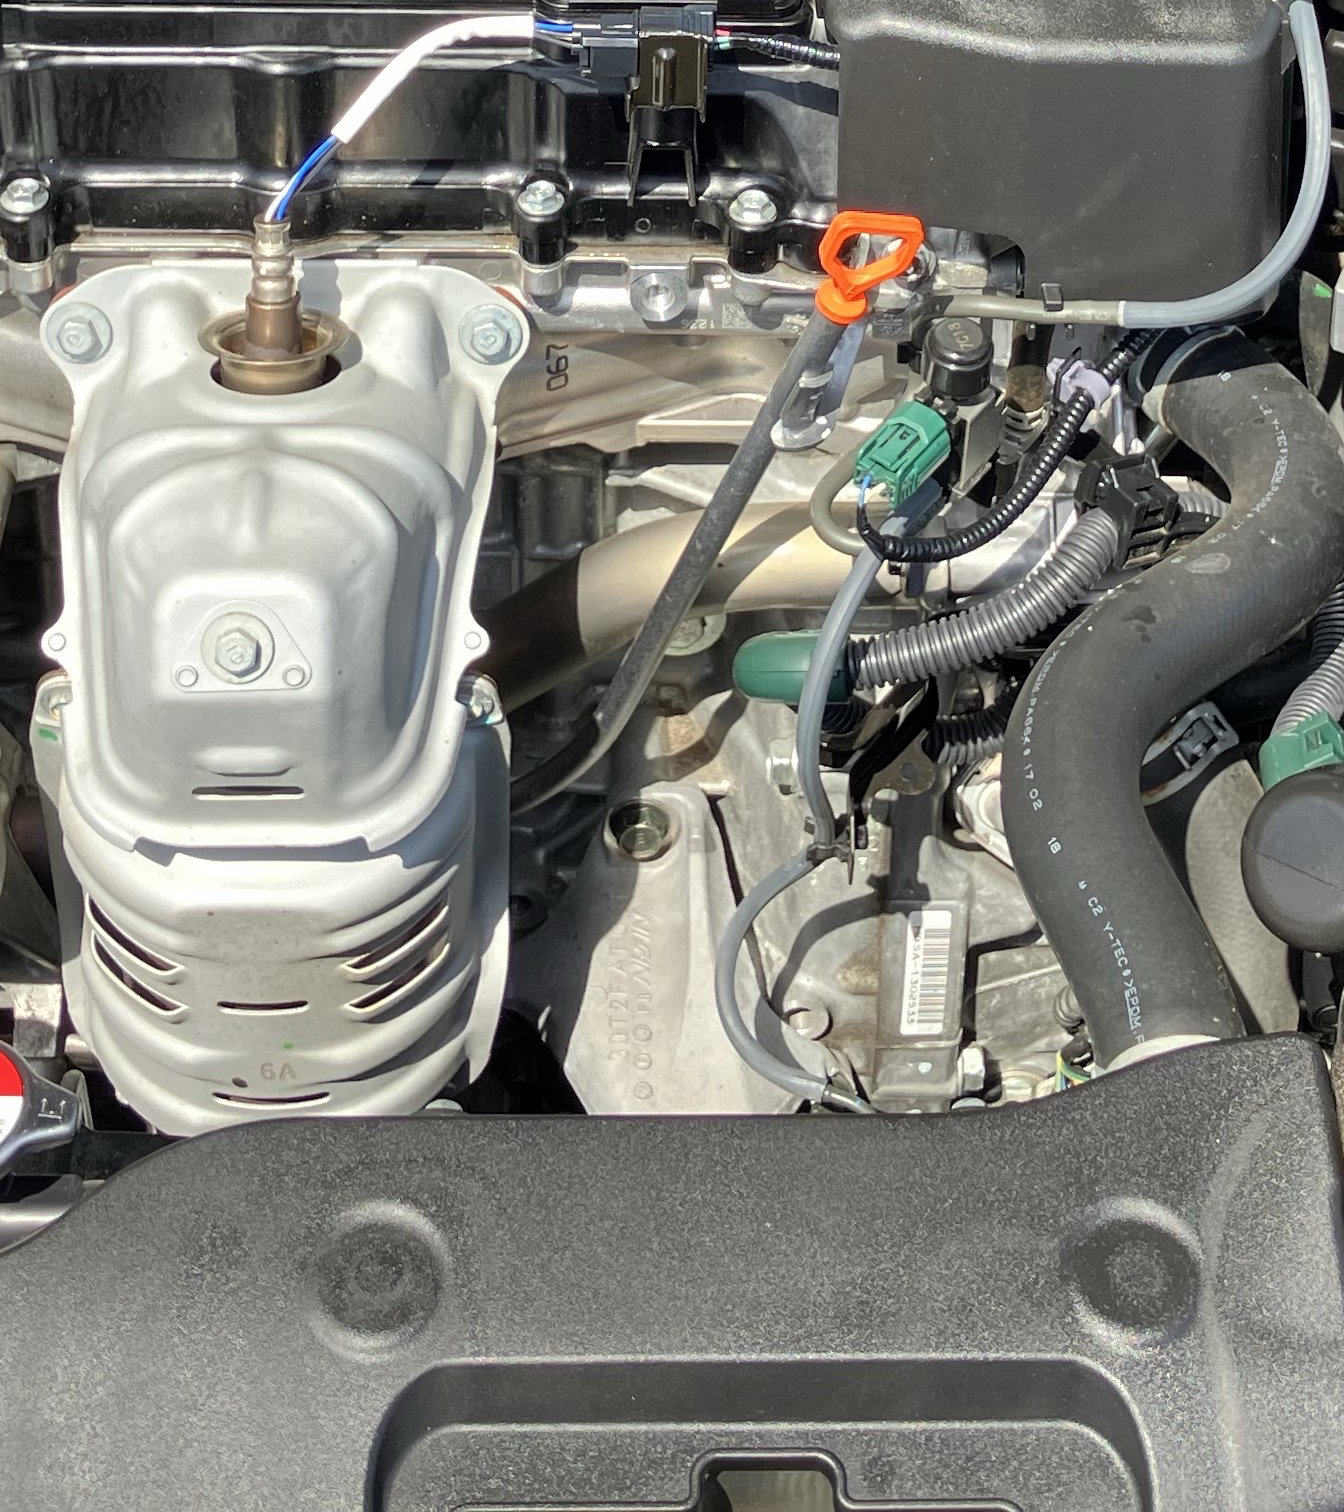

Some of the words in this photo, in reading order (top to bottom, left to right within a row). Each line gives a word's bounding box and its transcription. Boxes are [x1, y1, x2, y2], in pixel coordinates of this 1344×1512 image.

[545, 344, 569, 391] 067
[1027, 788, 1044, 812] 02
[1086, 896, 1105, 918] C2
[1102, 921, 1129, 968] Y-TEC
[260, 1062, 297, 1080] 6A
